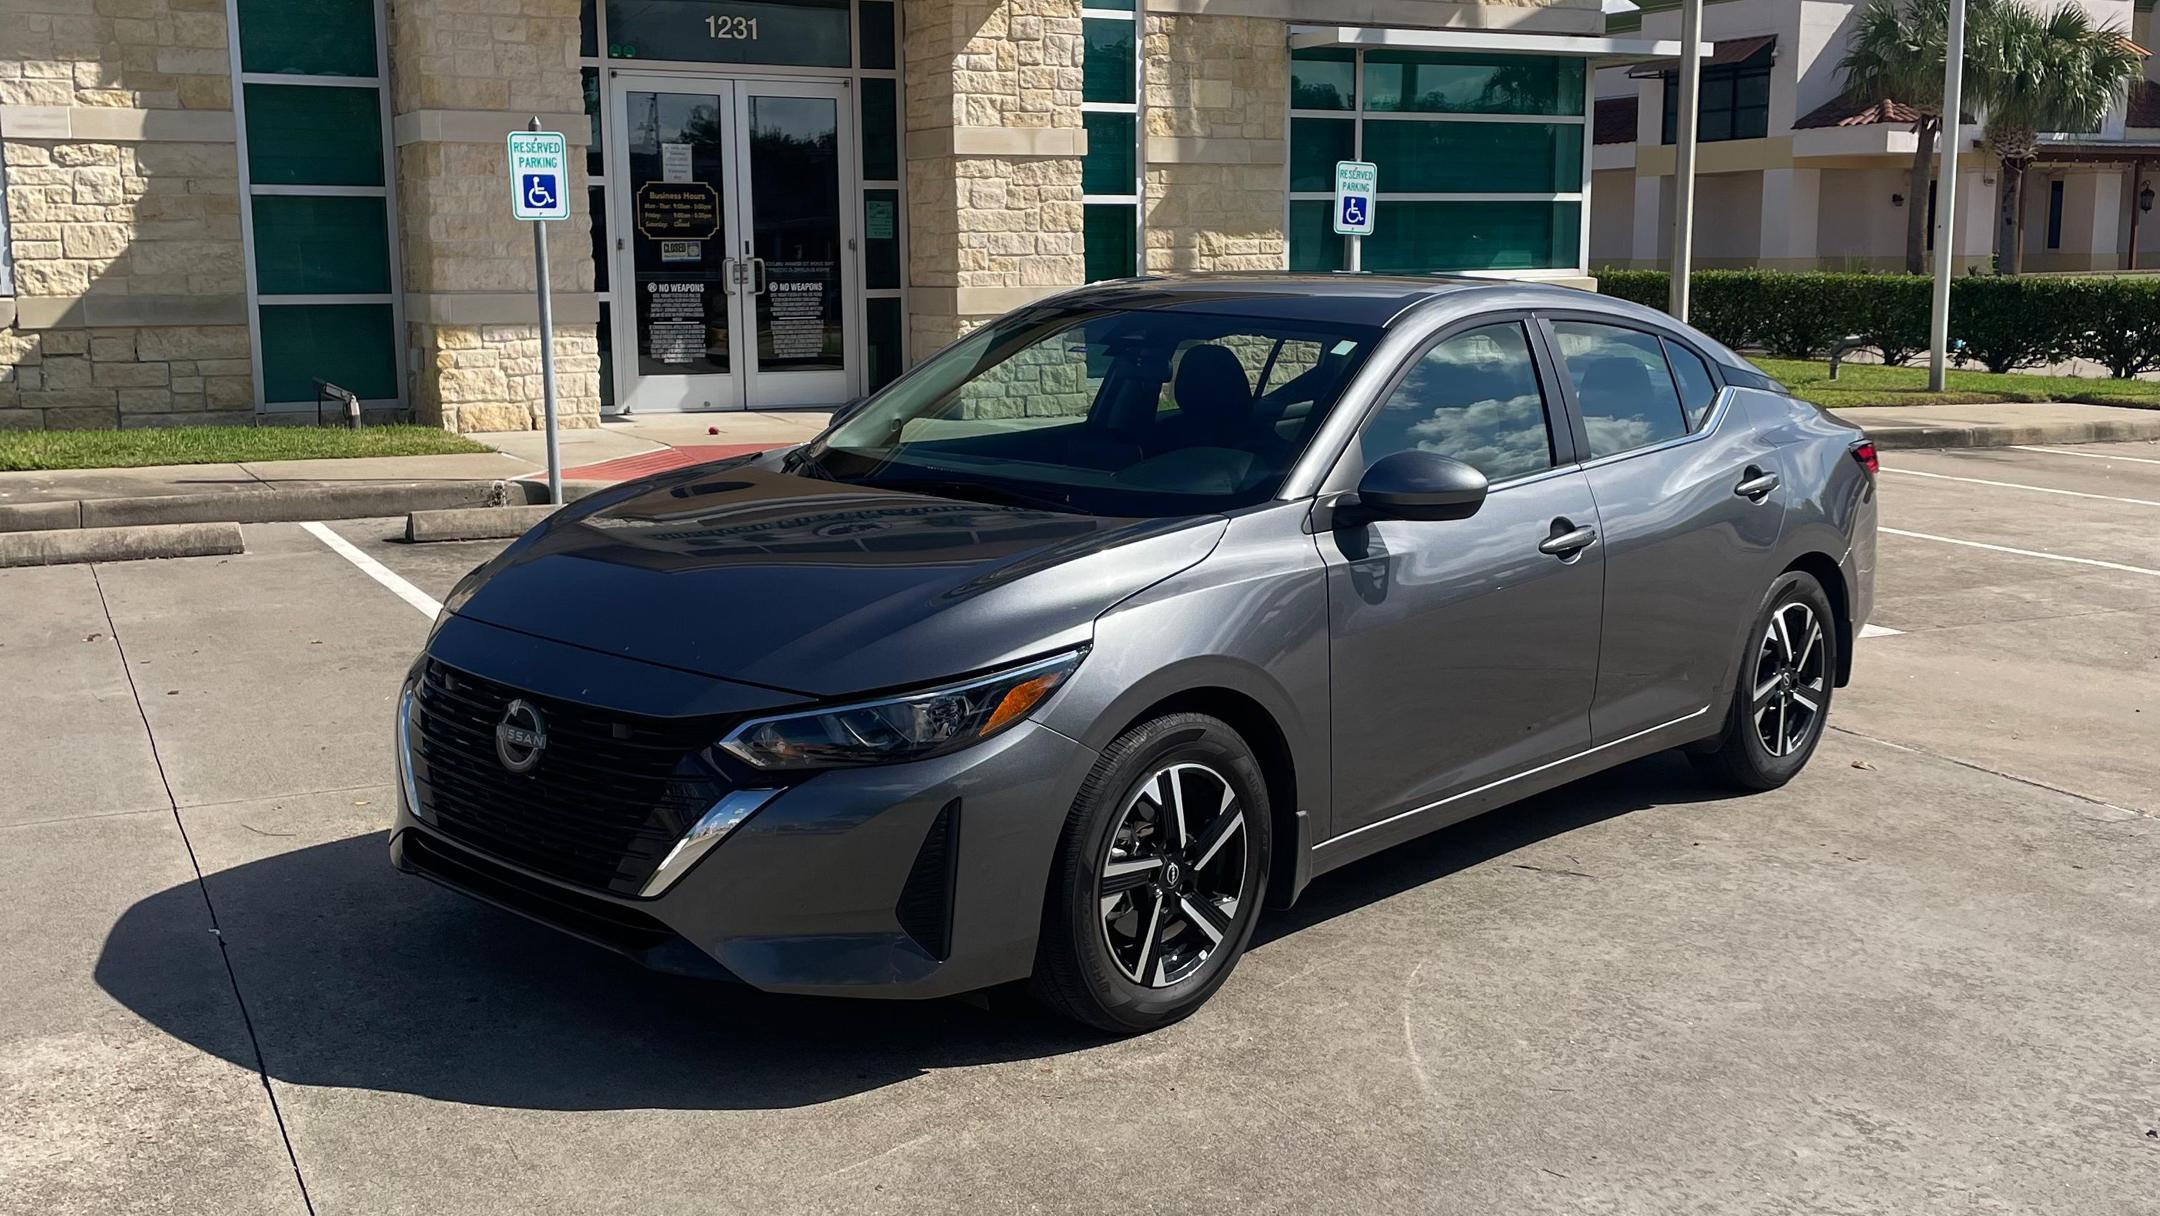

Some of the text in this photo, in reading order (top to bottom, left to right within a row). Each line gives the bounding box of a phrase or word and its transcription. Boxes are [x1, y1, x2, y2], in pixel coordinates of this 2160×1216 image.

[704, 15, 758, 40] 1231
[513, 142, 560, 154] RESERVED
[518, 157, 557, 168] PARKING
[1339, 169, 1373, 181] RESERVED
[1342, 182, 1370, 192] PARKING
[649, 191, 706, 200] Business Hours
[663, 243, 686, 253] CLOSED
[658, 283, 704, 292] NO WEAPONS
[779, 282, 823, 291] NO WEAPONS
[496, 725, 544, 746] NISSAN
